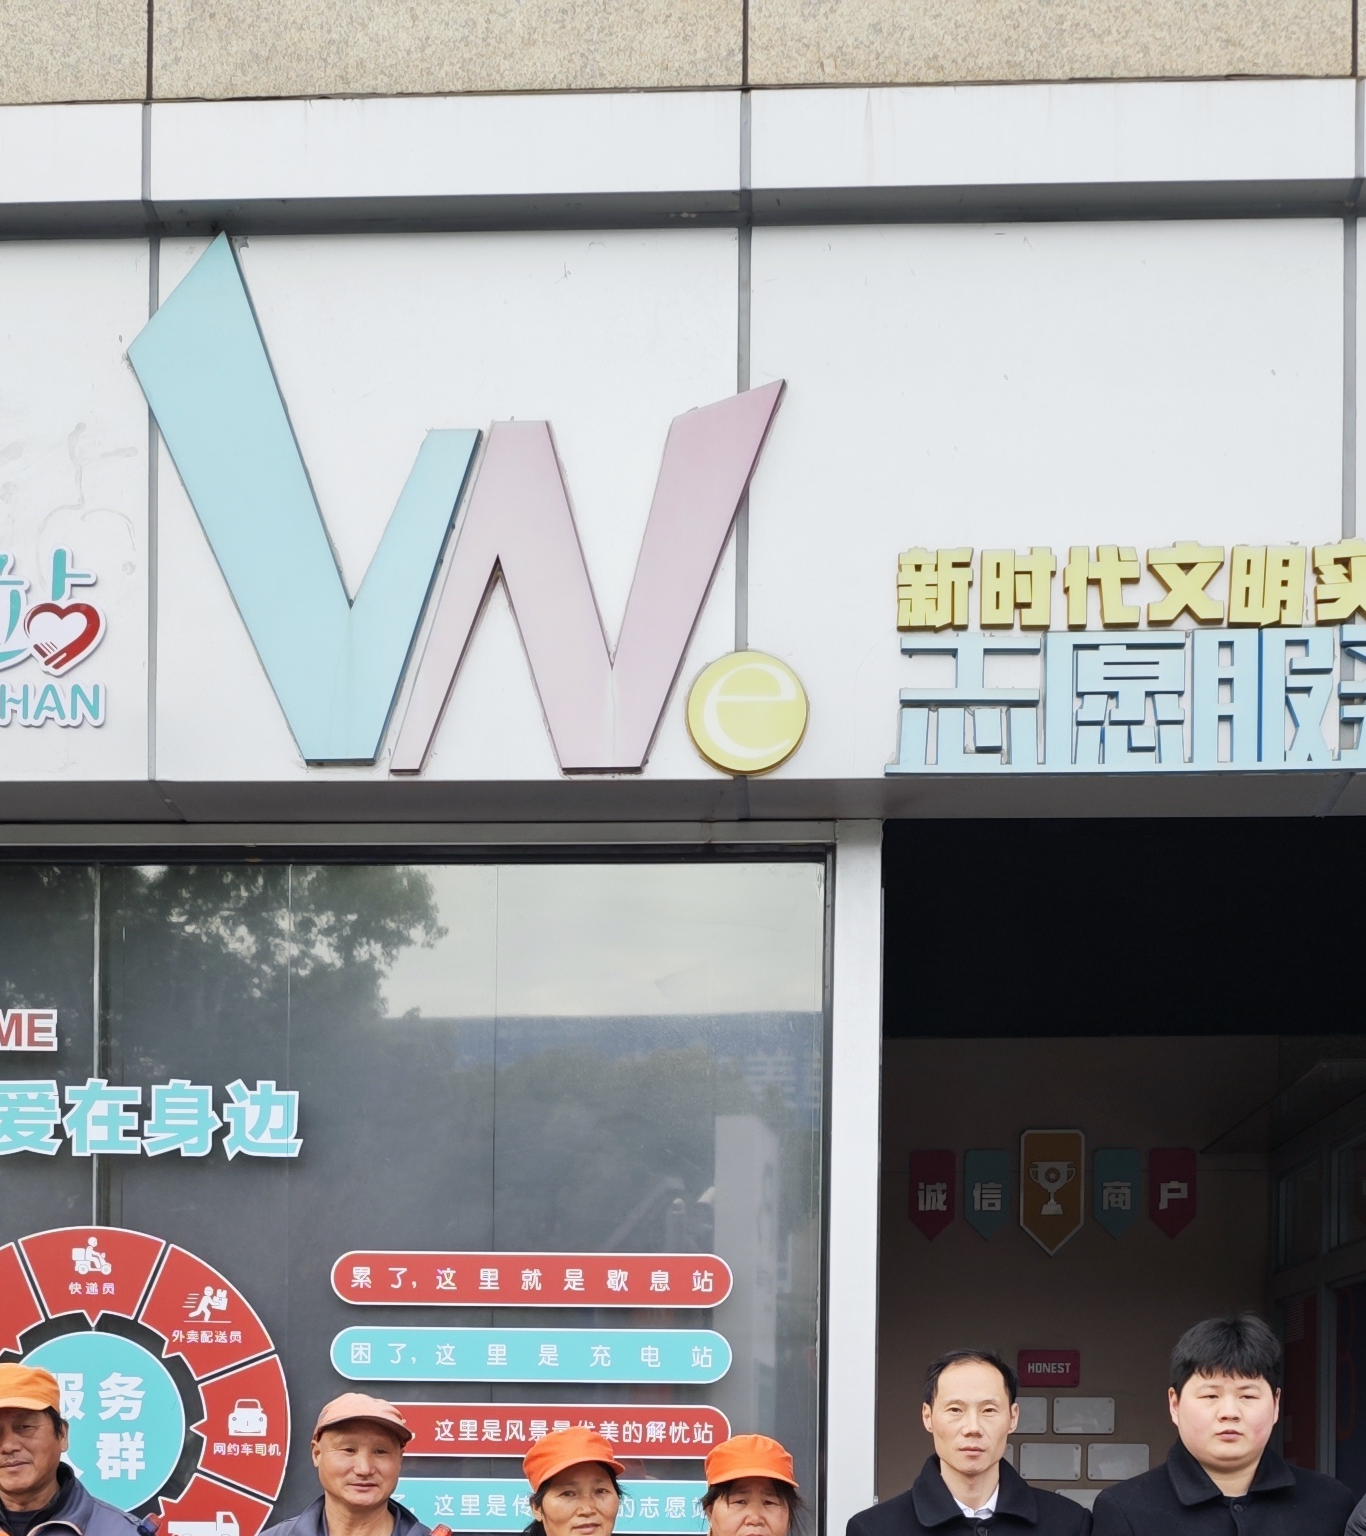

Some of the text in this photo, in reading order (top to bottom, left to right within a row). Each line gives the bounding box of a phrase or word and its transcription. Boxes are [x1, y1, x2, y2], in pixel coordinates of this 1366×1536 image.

[69, 1281, 115, 1297] 快递员
[171, 1329, 243, 1345] 外卖配送员
[1027, 1362, 1072, 1375] HONEST
[212, 1442, 282, 1457] 网约车司机
